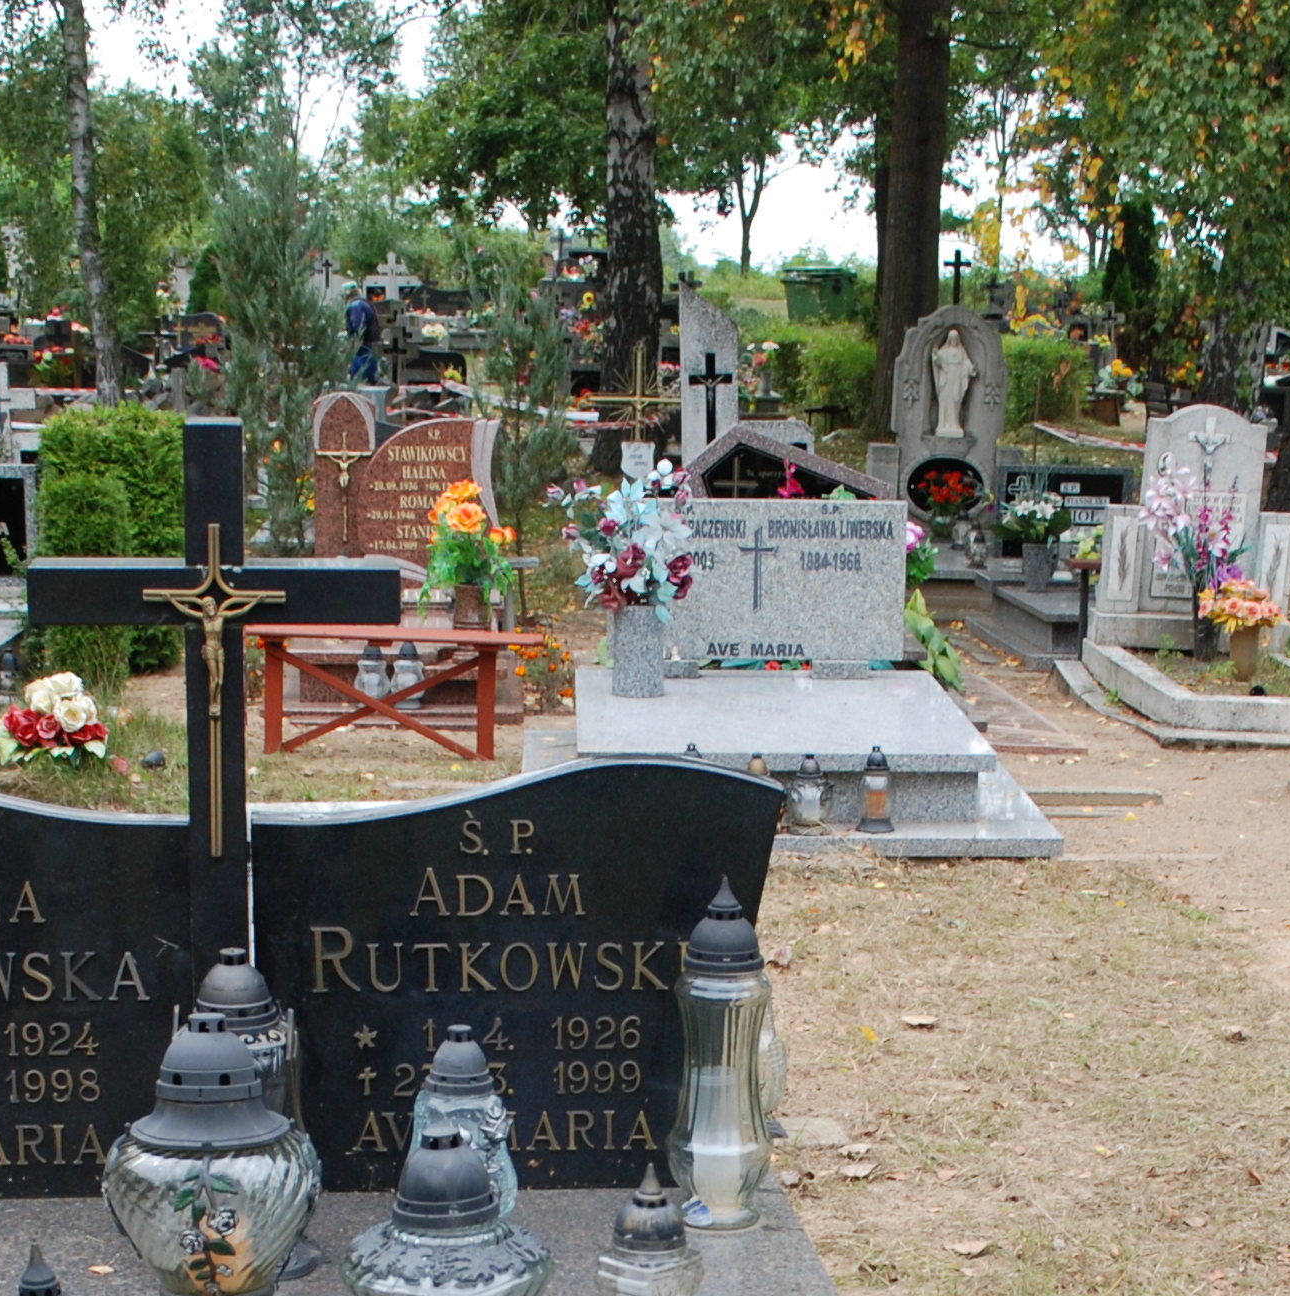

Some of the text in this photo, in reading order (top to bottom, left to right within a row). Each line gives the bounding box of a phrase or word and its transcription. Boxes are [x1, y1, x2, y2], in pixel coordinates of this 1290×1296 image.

[387, 445, 467, 462] STAWIKOWSCY
[402, 466, 446, 479] HALINA
[400, 496, 439, 508] ROMA
[690, 519, 746, 540] RACZEWSKI
[768, 519, 895, 541] BRONISŁAWA LIWERSKA
[706, 642, 805, 657] AVE MARIA
[409, 866, 587, 918] ADAM
[3, 1021, 101, 1058] 1924
[551, 1015, 642, 1051] 1926
[5, 1068, 101, 1104] 1998
[552, 1060, 642, 1095] 1999
[352, 1110, 414, 1153] AV
